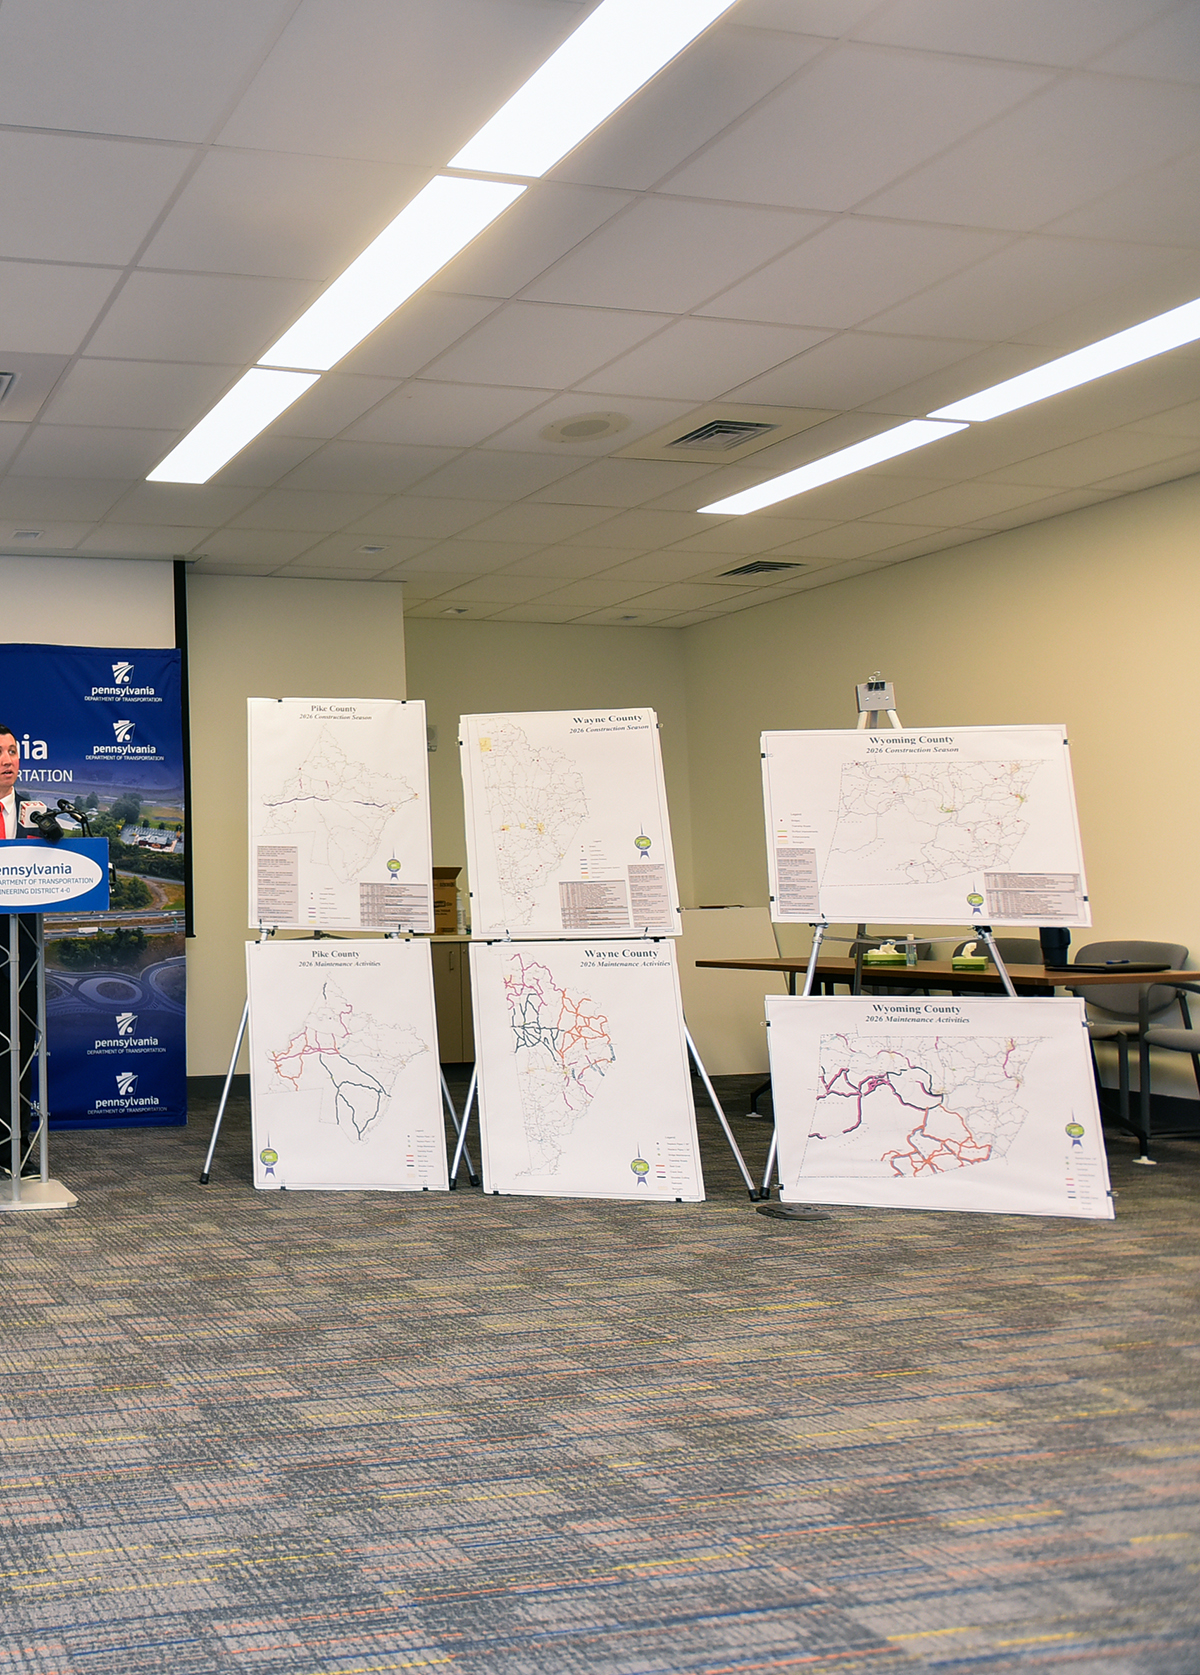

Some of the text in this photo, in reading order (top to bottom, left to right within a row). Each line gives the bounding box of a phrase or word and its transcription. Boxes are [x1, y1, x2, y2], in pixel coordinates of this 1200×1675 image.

[92, 686, 155, 697] pennsylvania
[329, 705, 357, 714] County
[869, 736, 954, 746] Wyoming County
[93, 744, 156, 755] pennsylvania
[331, 950, 359, 959] County
[584, 949, 658, 960] Wayne County
[872, 1004, 961, 1015] Wyoming County
[95, 1036, 158, 1049] pennsylvania
[95, 1096, 159, 1109] pennsylvania
